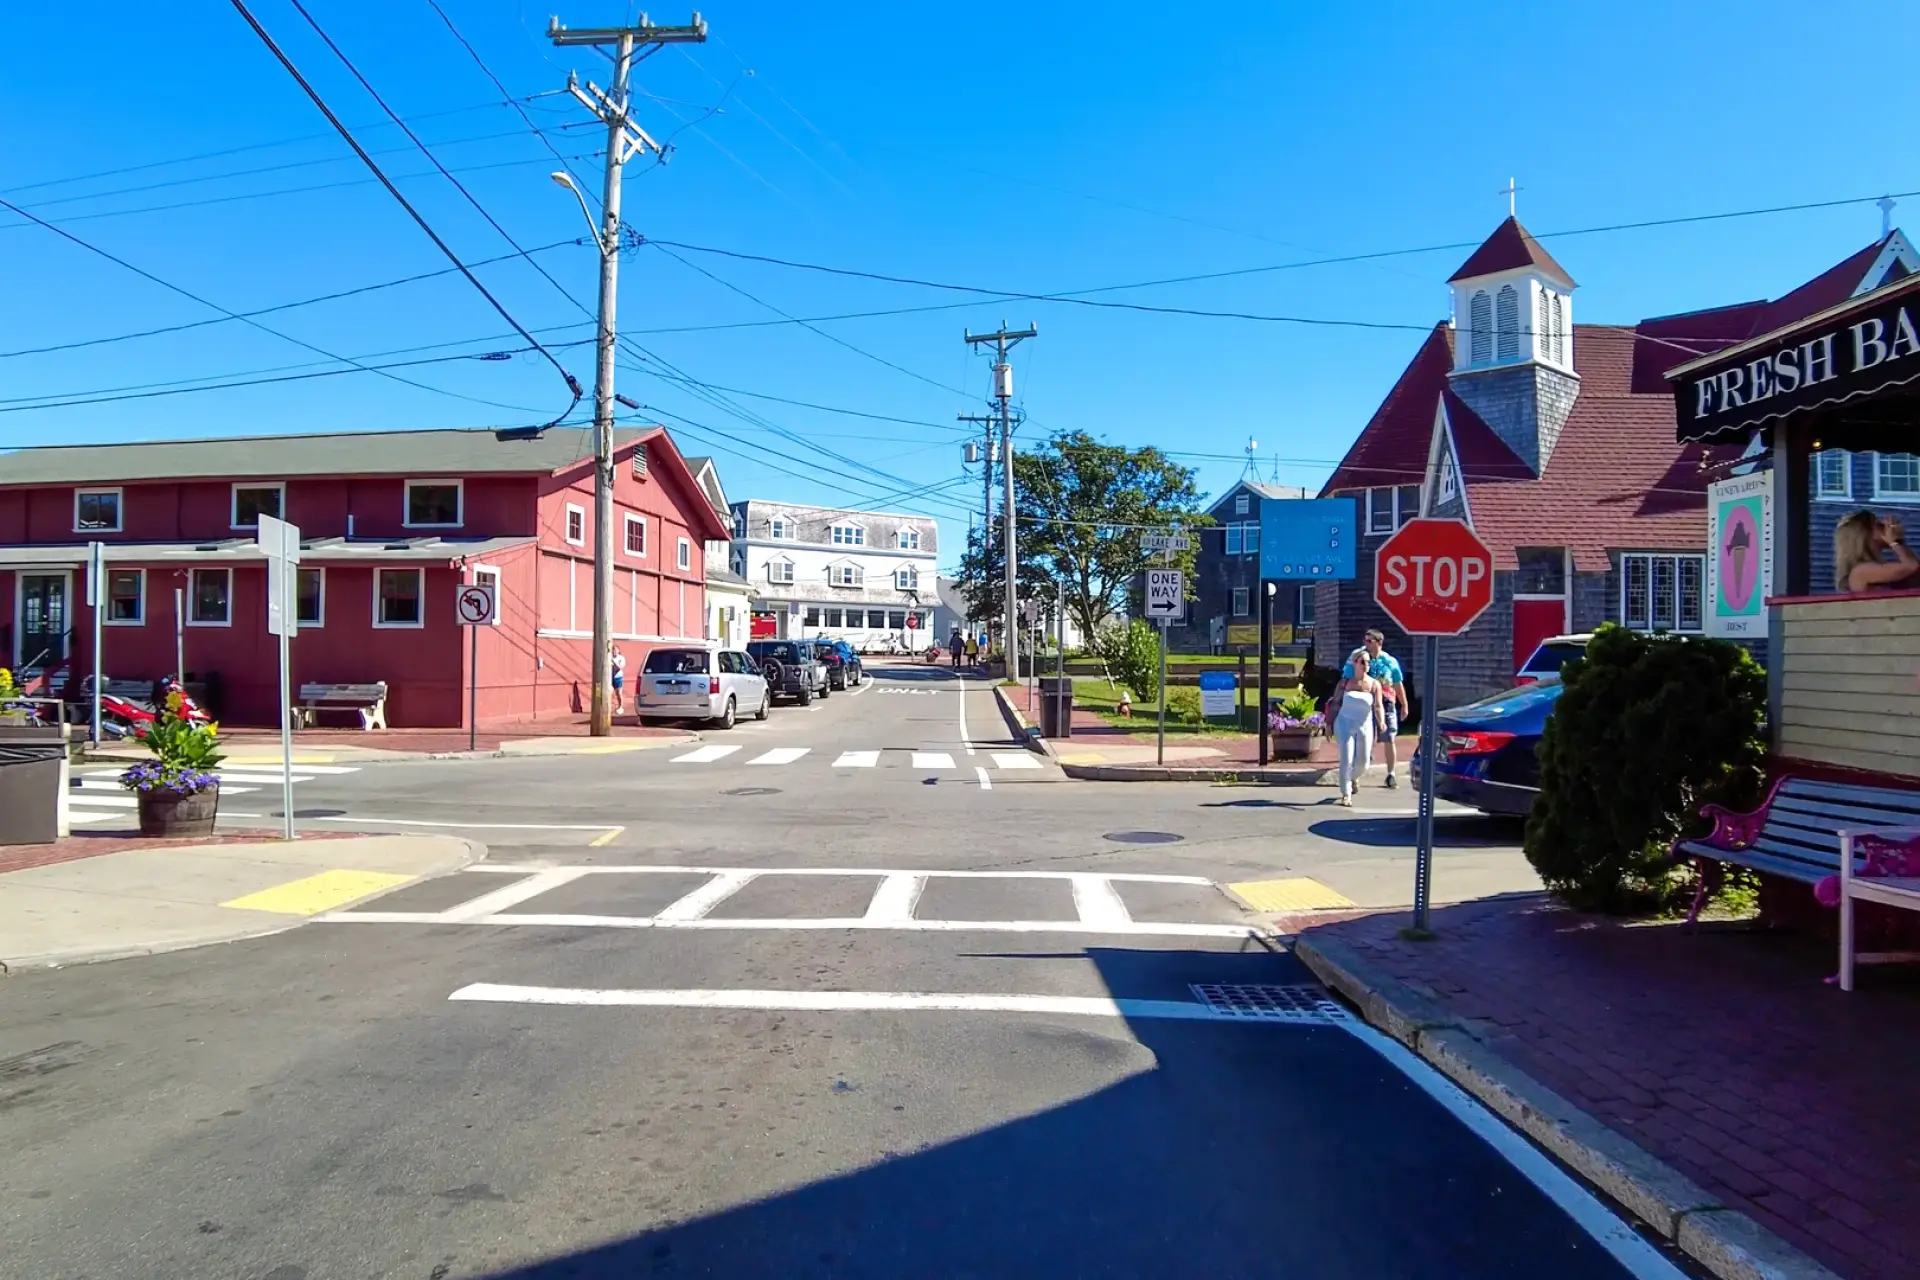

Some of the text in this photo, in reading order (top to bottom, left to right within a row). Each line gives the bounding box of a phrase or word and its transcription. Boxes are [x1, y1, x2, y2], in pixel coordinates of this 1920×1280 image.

[1694, 306, 1920, 420] FRESH BA
[1151, 537, 1170, 549] LAKE
[1175, 539, 1189, 549] AVE
[1151, 573, 1179, 584] ONE
[1383, 555, 1486, 598] STOP
[1151, 586, 1178, 598] WAY
